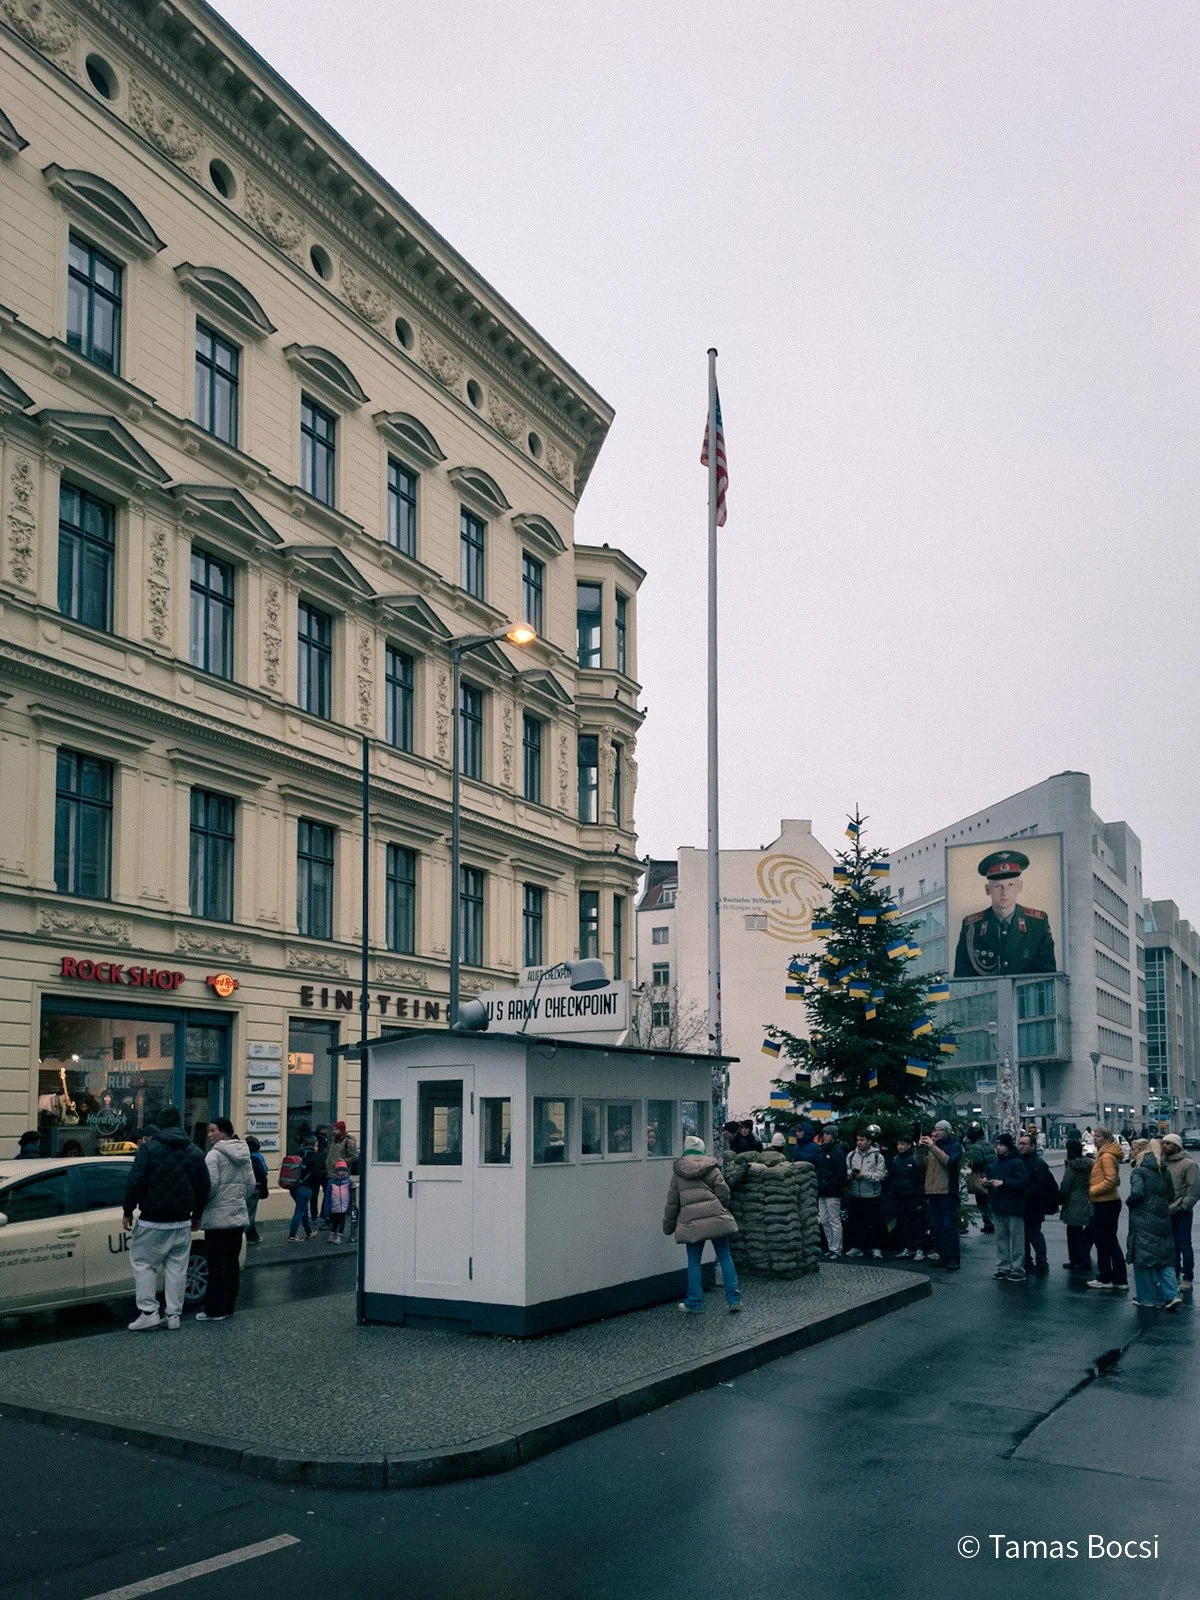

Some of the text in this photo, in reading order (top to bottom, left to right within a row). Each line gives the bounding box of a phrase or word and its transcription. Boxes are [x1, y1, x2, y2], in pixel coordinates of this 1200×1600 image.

[752, 897, 781, 905] Stiftungen
[60, 956, 186, 991] ROCK SHOP
[487, 992, 619, 1022] U S ARMY CHECKPOINT
[84, 1074, 131, 1090] CRLIE
[86, 1112, 128, 1126] Hard Rock
[107, 1232, 132, 1255] Ub
